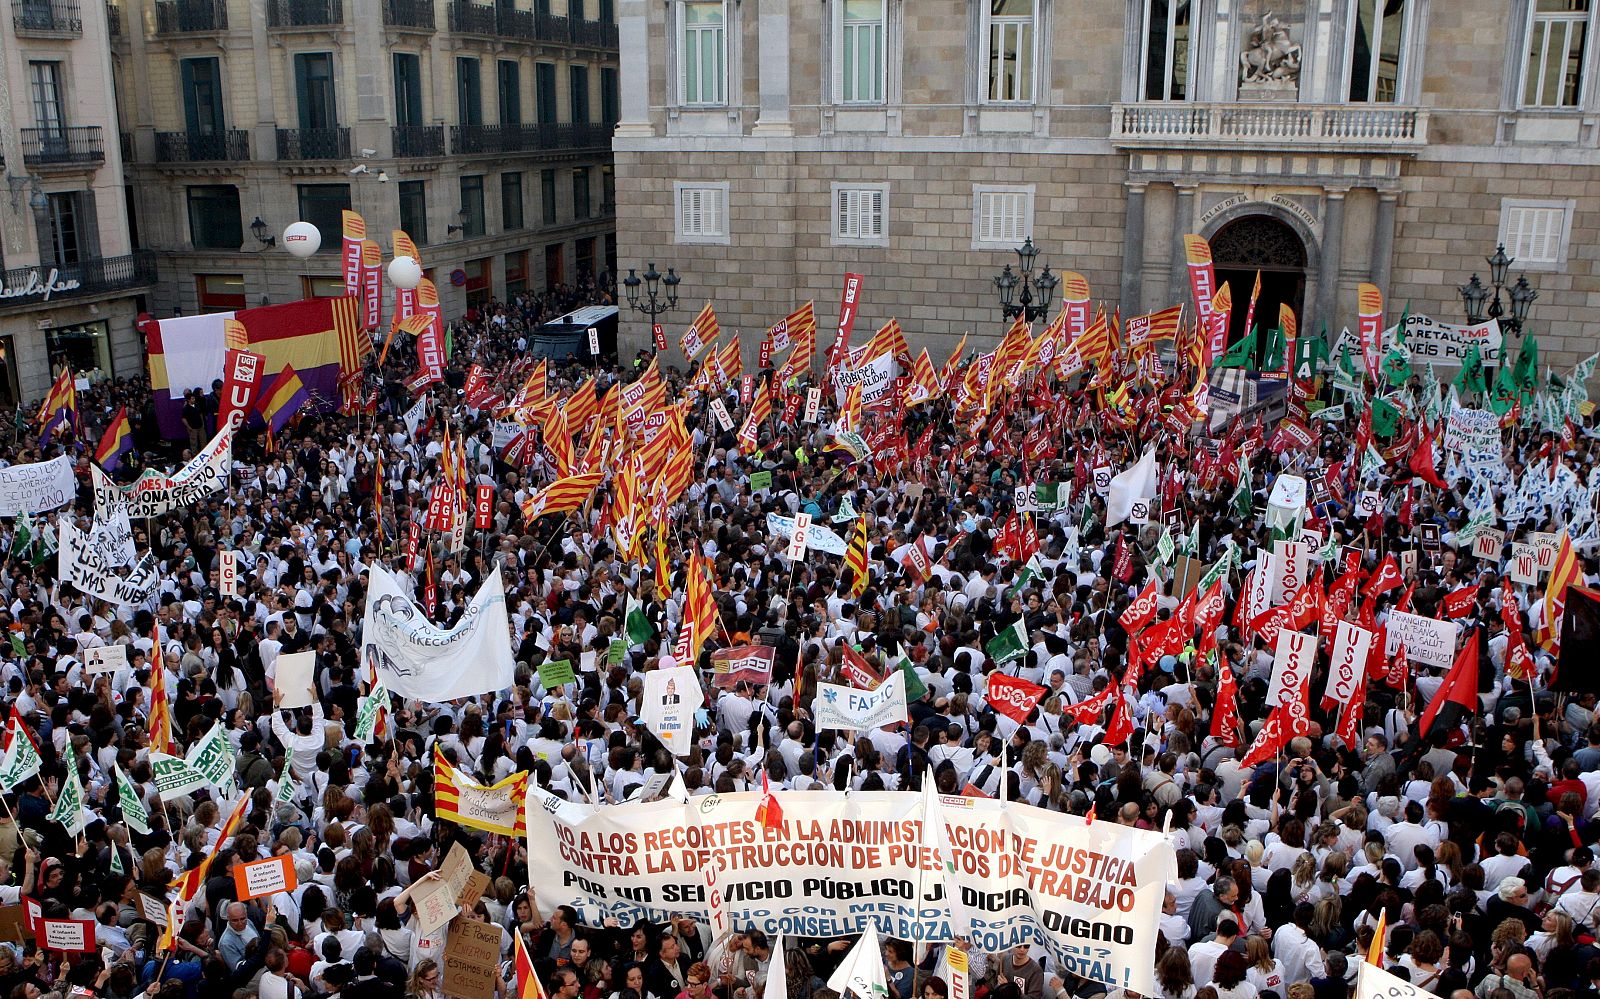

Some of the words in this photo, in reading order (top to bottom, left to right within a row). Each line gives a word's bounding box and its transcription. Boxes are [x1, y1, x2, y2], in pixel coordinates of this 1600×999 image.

[1202, 203, 1225, 223] PALAU
[1225, 198, 1236, 207] DE
[1238, 195, 1249, 203] LA
[1271, 196, 1317, 226] GENERALITAT
[366, 271, 378, 326] CCOO
[589, 331, 598, 352] UGT
[654, 327, 666, 349] UGT
[1458, 327, 1490, 338] TMB
[241, 356, 256, 366] UGT
[761, 343, 769, 367] UGT
[467, 366, 482, 391] UGT
[743, 377, 751, 401] UGT
[863, 371, 888, 388] ALIDAD
[713, 401, 731, 429] UGT
[786, 397, 800, 422] UGT
[808, 390, 818, 420] UGT
[526, 431, 535, 463] UGT
[429, 486, 444, 529] UGT
[442, 491, 452, 532] UGT
[479, 488, 490, 526] UGT
[408, 526, 418, 565] UGT
[455, 515, 465, 550] UGT
[793, 516, 807, 556] UGT
[1479, 537, 1495, 555] NO
[223, 553, 234, 592] UGT
[1281, 543, 1298, 603] USOC
[1518, 556, 1532, 577] NO
[1253, 553, 1269, 617] USOC
[1119, 591, 1158, 626] USOC
[1390, 630, 1402, 640] NO
[1405, 632, 1415, 642] LA
[1419, 635, 1446, 649] SALUT
[1399, 623, 1409, 632] LA
[1335, 627, 1360, 699] USOC
[849, 684, 894, 712] FAPIC
[991, 684, 1036, 712] USOC
[553, 820, 576, 848] NO
[580, 831, 595, 853] A
[598, 832, 639, 855] LOS
[644, 820, 756, 851] RECORTES
[763, 820, 791, 842] EN
[796, 819, 825, 842] LA
[829, 819, 1005, 854] ADMINISTACIÓN
[1012, 832, 1038, 864] DE
[1041, 843, 1138, 887] JUSTICIA
[559, 841, 640, 877] CONTRA
[645, 850, 676, 875] LA
[681, 840, 845, 872] DESTRUCCIÓN
[852, 846, 882, 869] DE
[887, 844, 991, 879] PUESTOS
[998, 853, 1024, 879] DE
[1026, 865, 1135, 913] TRABAJO
[563, 870, 608, 899] POR
[661, 879, 793, 902] SEVICIO
[802, 876, 914, 900] PÚBLICO
[923, 883, 1034, 913] JDICIA
[1043, 909, 1135, 945] DIGNO
[705, 865, 723, 932] UGT
[783, 904, 837, 916] con
[461, 921, 471, 937] TE
[473, 924, 500, 945] PONGAS
[764, 913, 895, 937] CONSELLERA
[1056, 949, 1118, 985] TOTAL
[1123, 967, 1131, 987] !
[447, 956, 482, 975] ESTAMOS
[483, 968, 493, 979] EN
[452, 973, 486, 991] CRISIS
